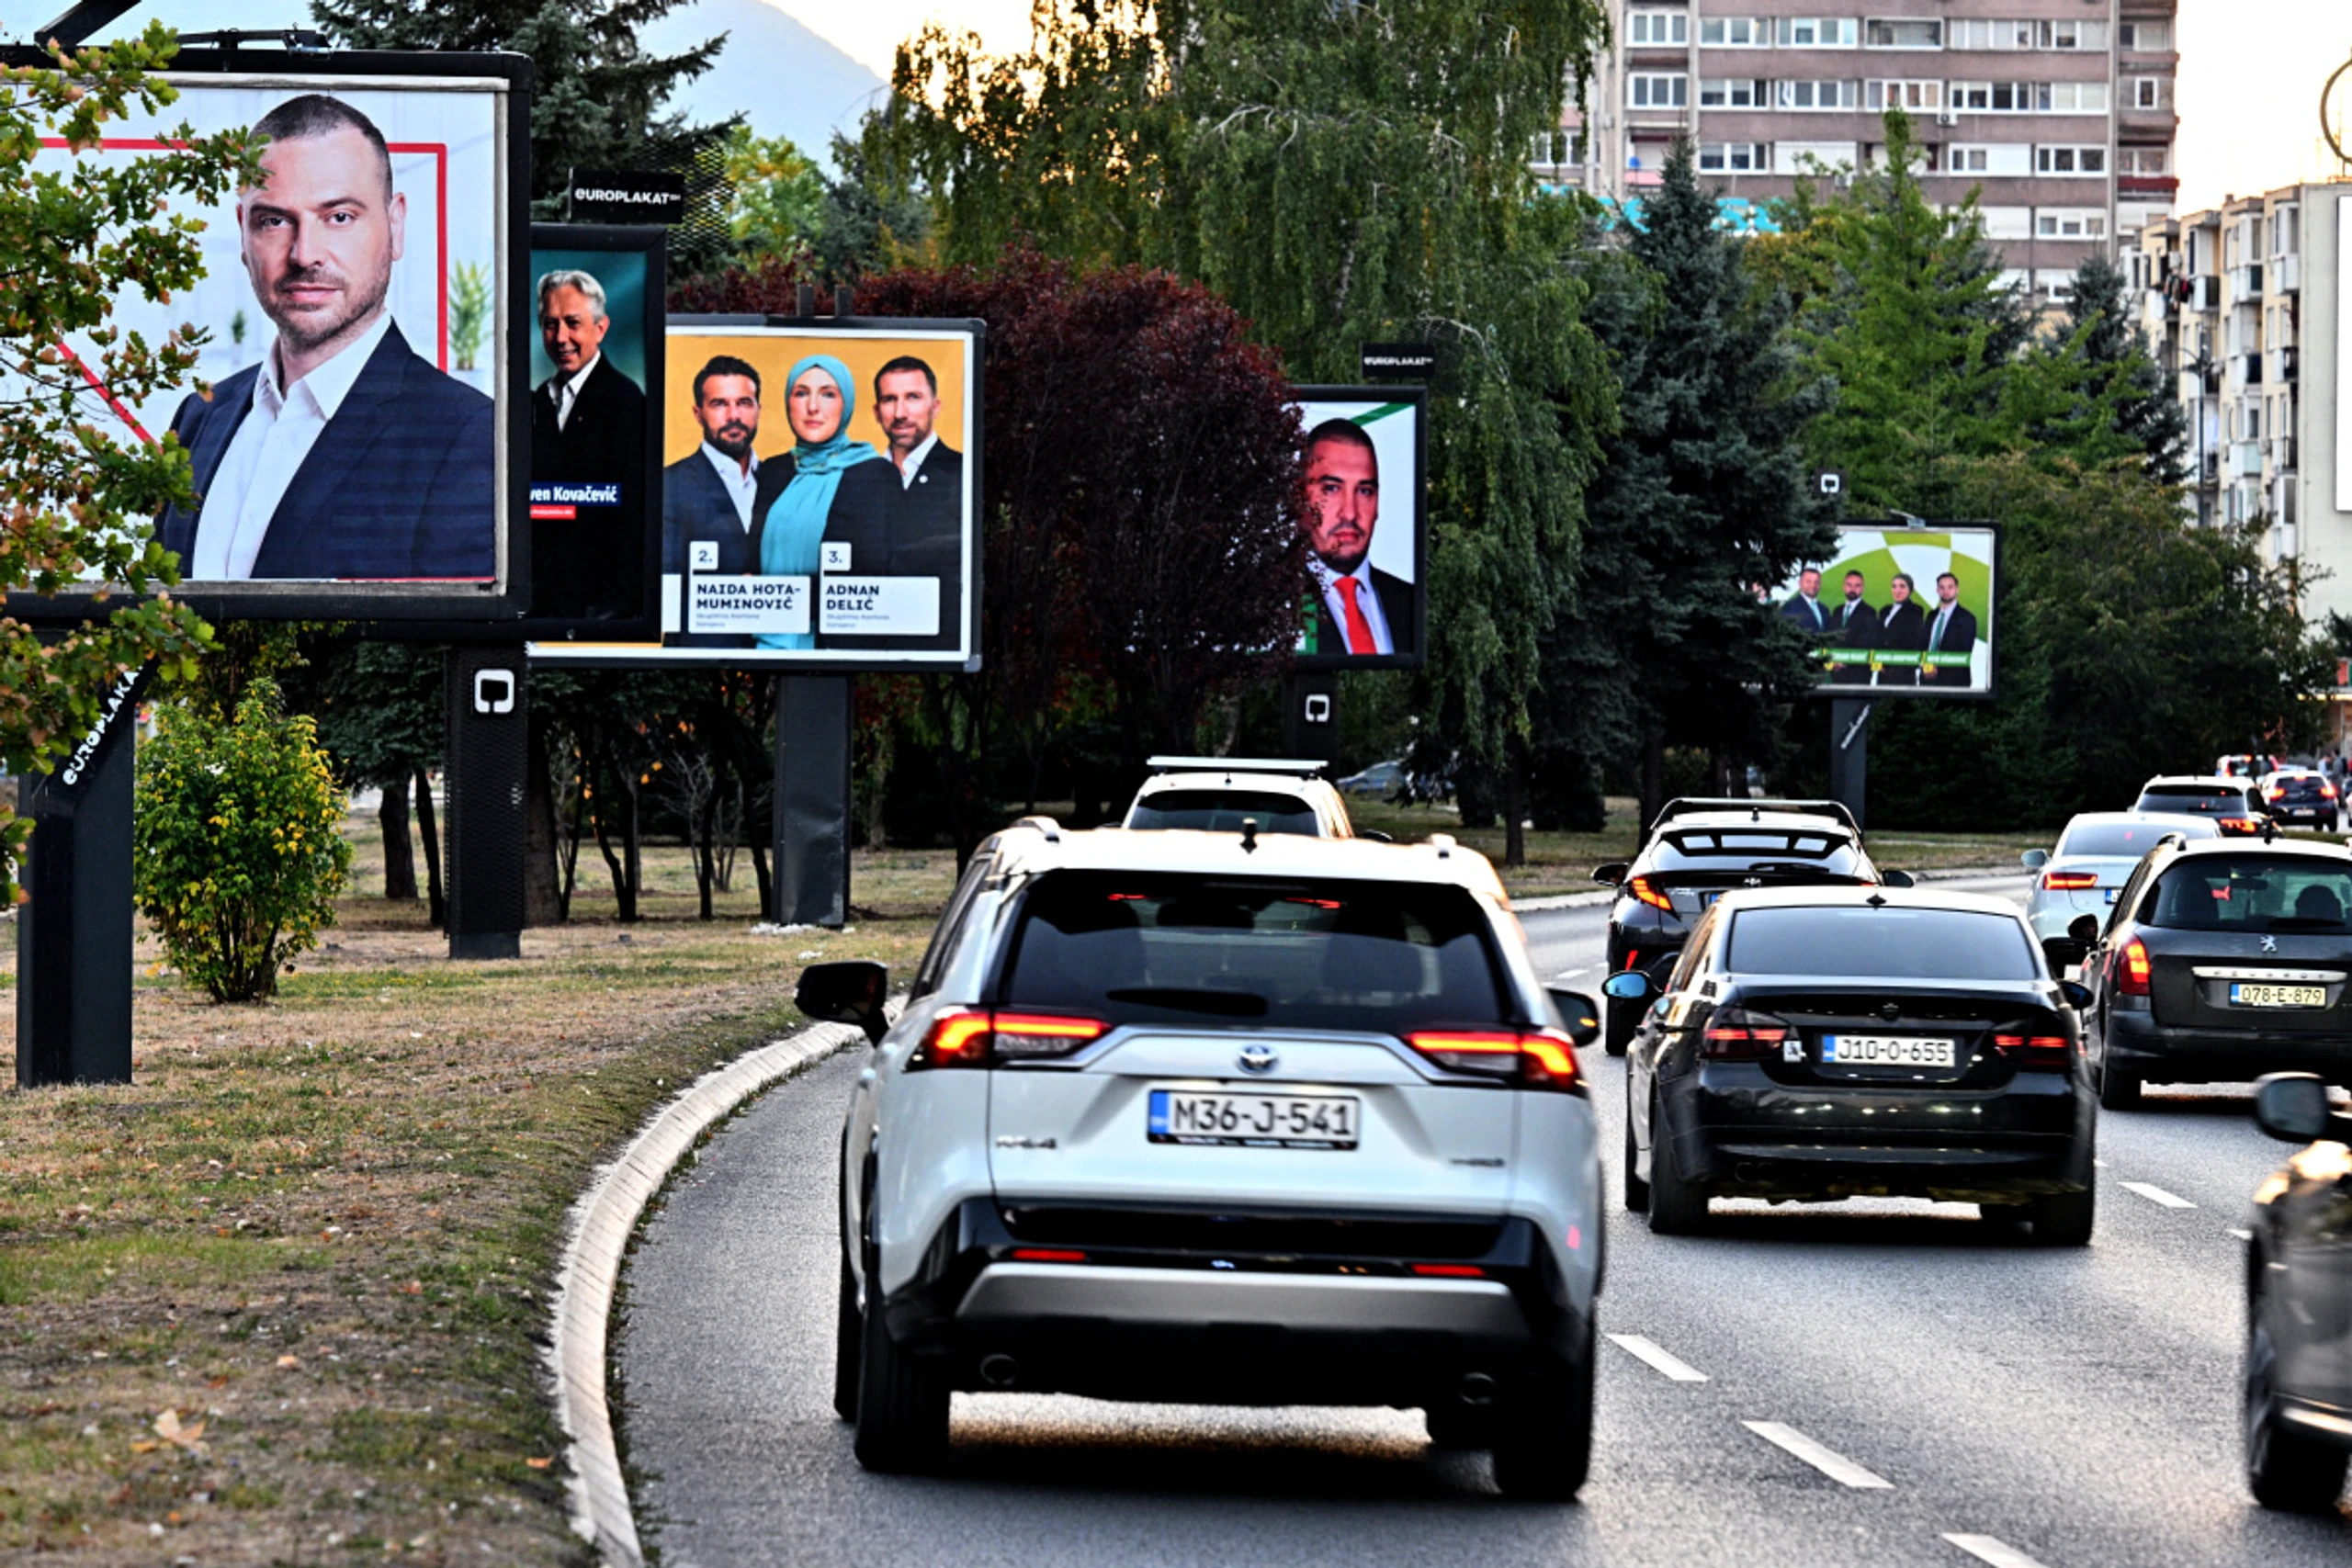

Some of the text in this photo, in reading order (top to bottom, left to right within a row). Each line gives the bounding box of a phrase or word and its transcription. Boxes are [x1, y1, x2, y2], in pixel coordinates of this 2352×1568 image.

[553, 484, 617, 502] Kovačević
[697, 549, 713, 563] 2.
[828, 550, 843, 564] 3.
[696, 583, 801, 595] NAIDA HOTA-
[826, 584, 880, 596] ADNAN
[695, 596, 794, 610] MUMINOVIĆ
[826, 596, 874, 611] DELIĆ
[62, 665, 144, 785] eUROPLAKA
[1173, 1099, 1351, 1136] M36-J-541
